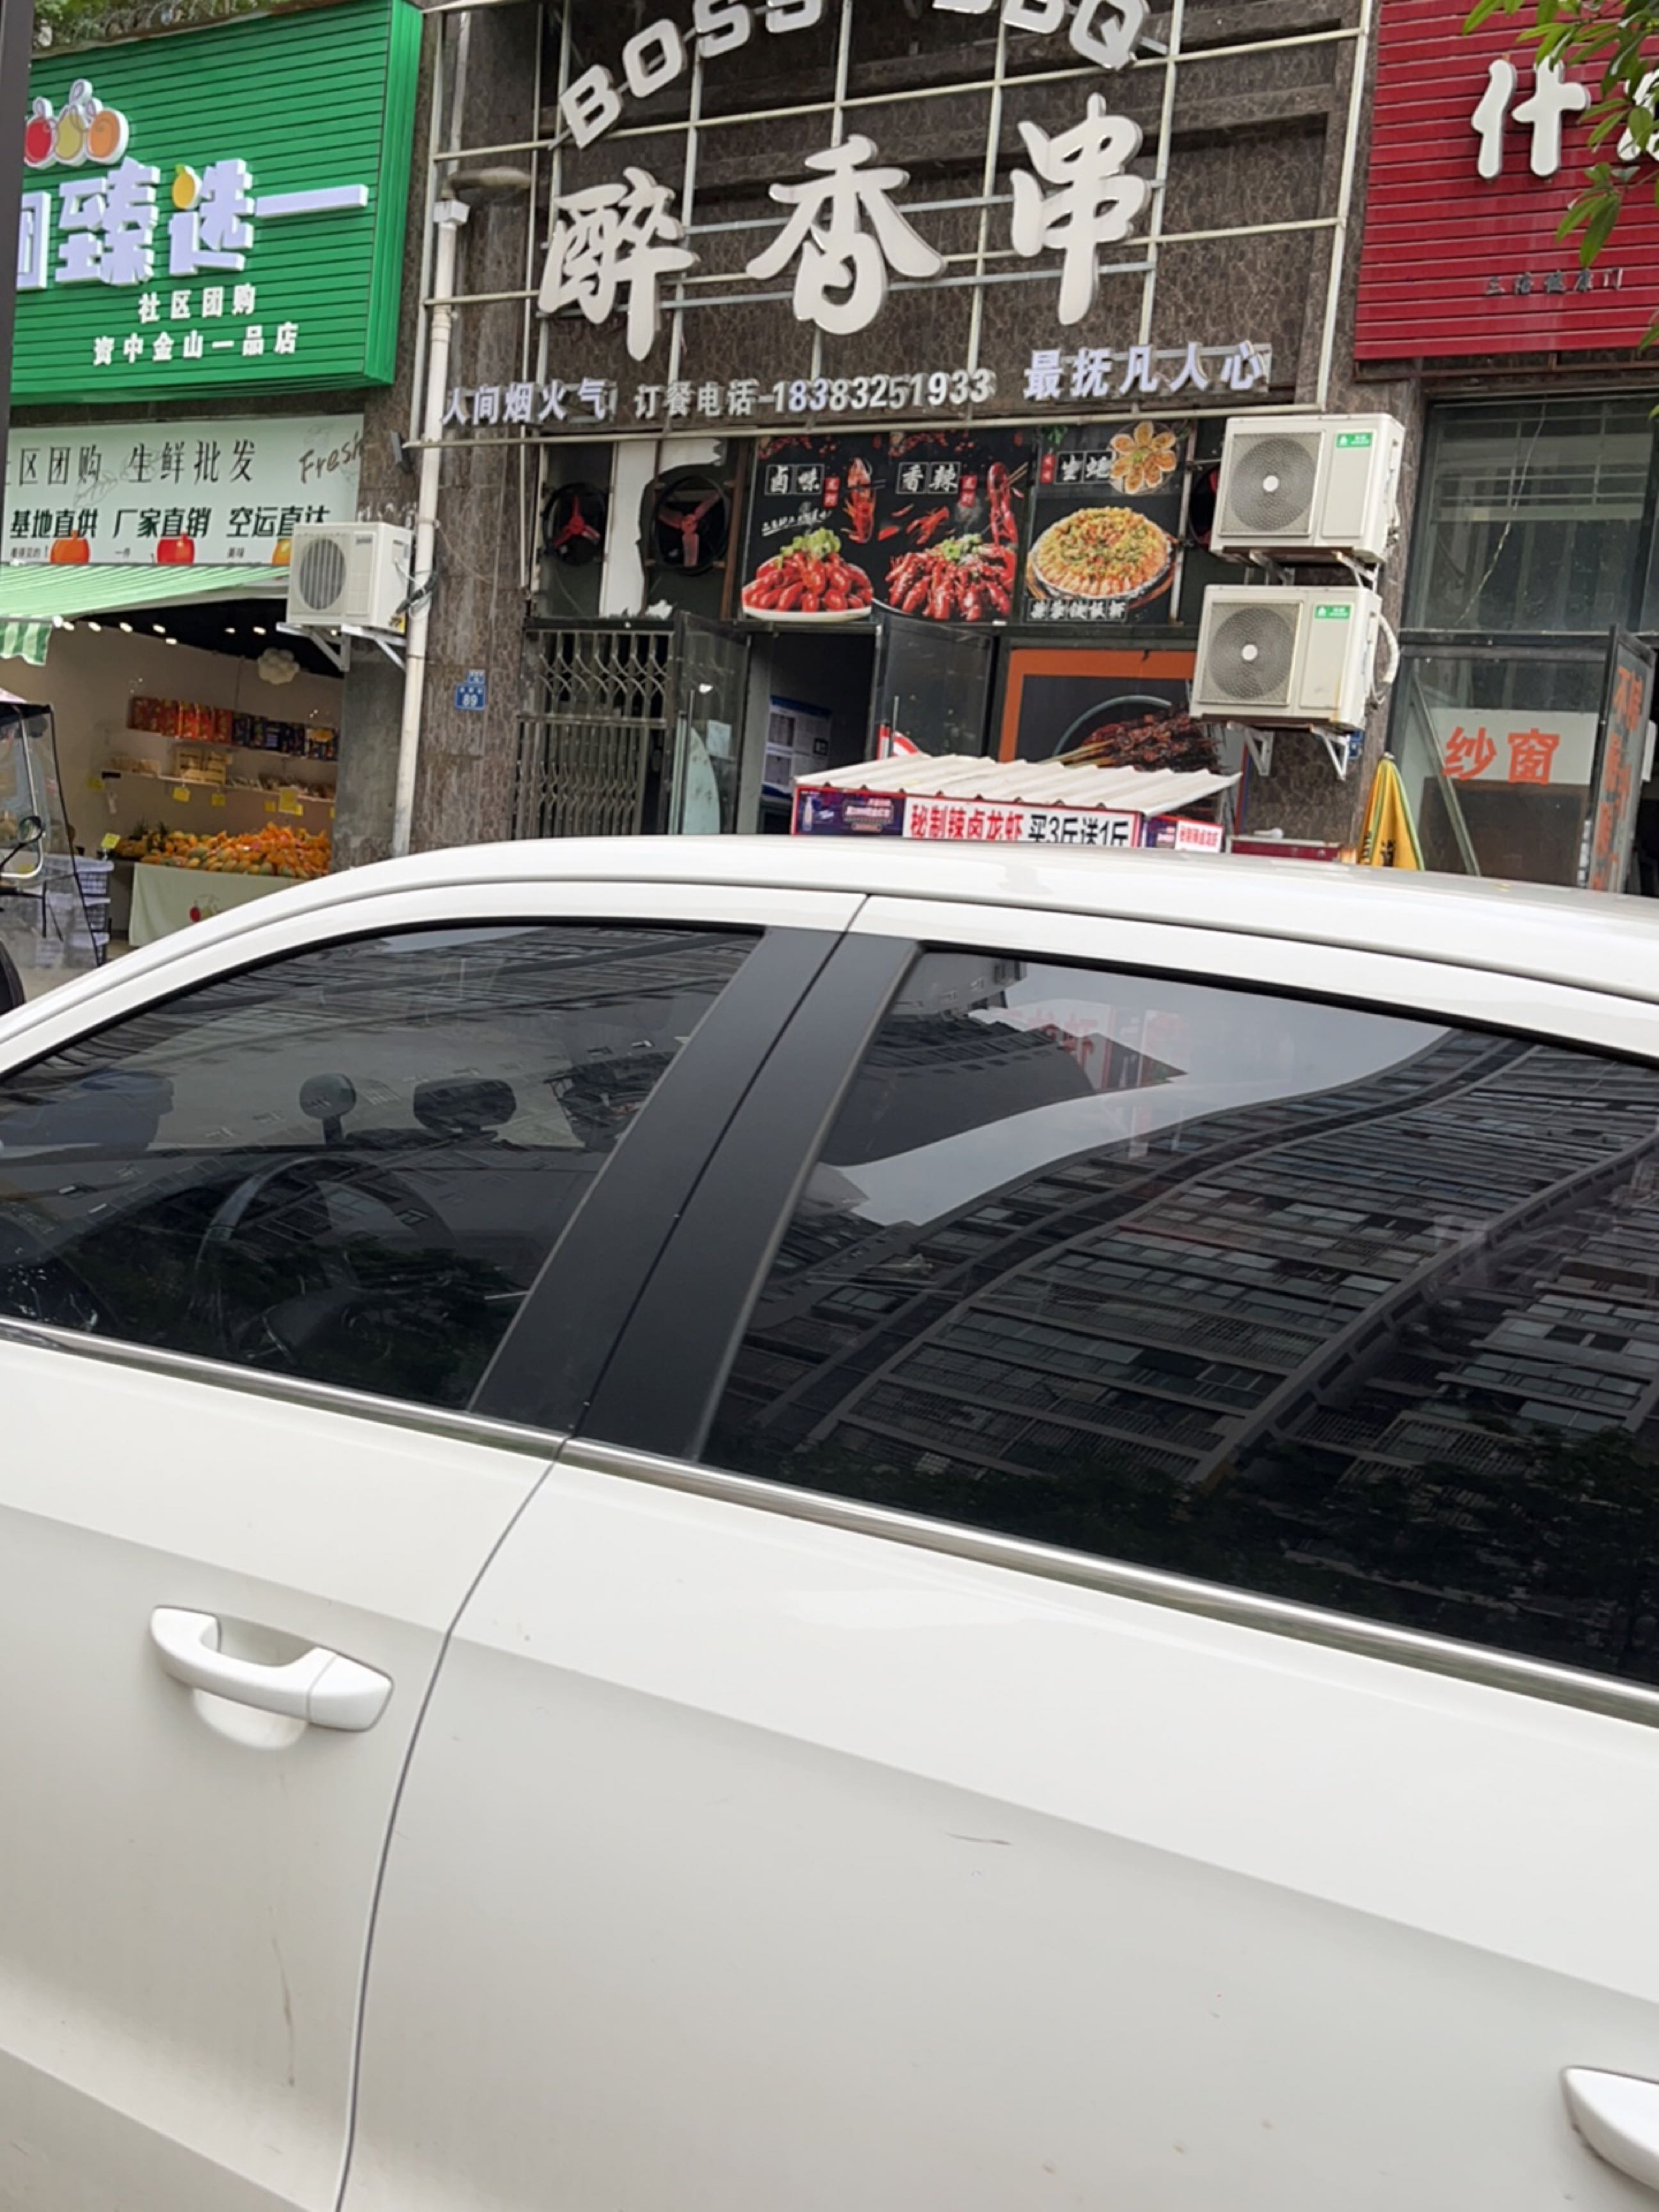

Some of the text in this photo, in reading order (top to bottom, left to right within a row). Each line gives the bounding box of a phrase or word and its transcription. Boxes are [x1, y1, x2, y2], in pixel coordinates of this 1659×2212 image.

[538, 92, 1146, 362] 醉香串
[138, 282, 256, 324] 社区团购
[93, 321, 299, 366] 资中金山一品店
[440, 378, 607, 426] 人间烟火气
[1023, 340, 1263, 401] 最抚凡人心
[5, 439, 256, 488] 区团购 生鲜批发
[10, 508, 98, 538] 基地直供
[113, 507, 212, 538] 厂家直销
[1443, 725, 1560, 786] 纱窗
[910, 804, 1024, 842] 秘制辣卤龙虾
